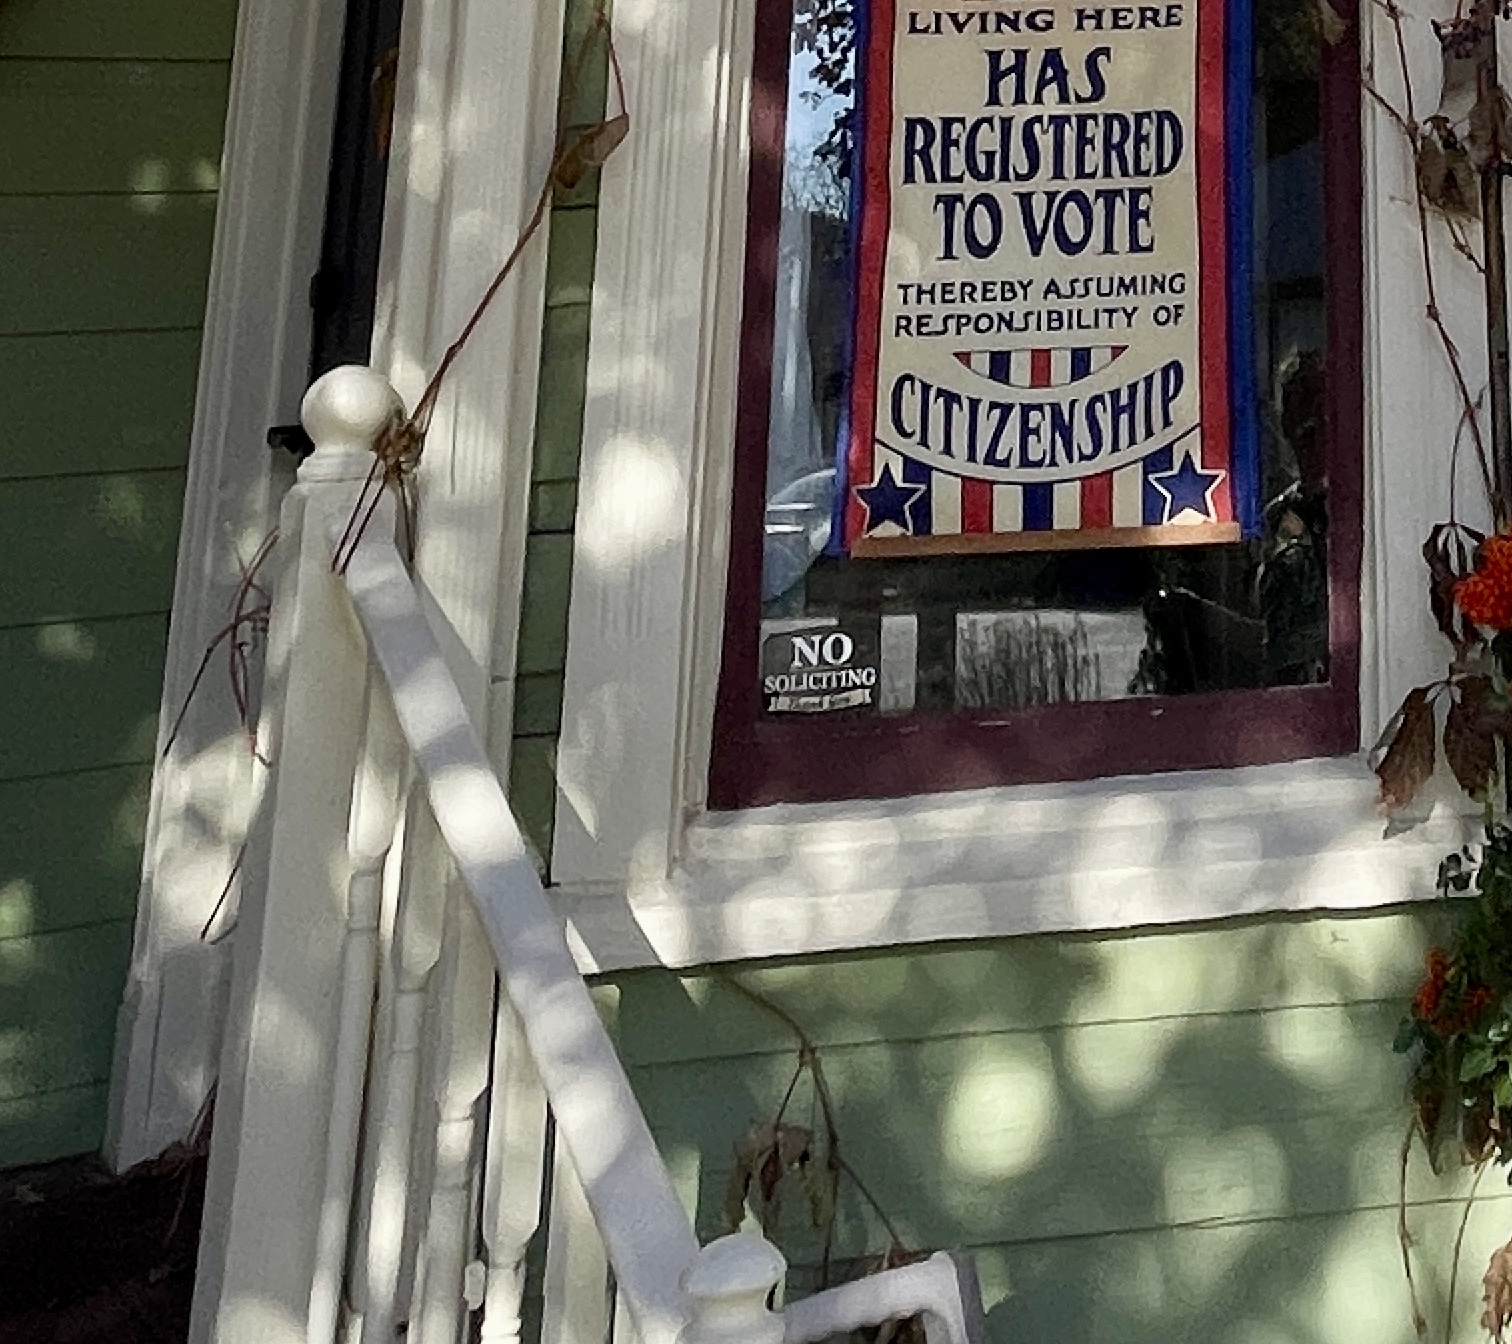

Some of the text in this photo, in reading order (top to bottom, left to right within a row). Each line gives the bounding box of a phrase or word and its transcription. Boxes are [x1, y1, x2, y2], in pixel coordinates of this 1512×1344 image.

[908, 5, 1182, 34] LIVING HERE
[984, 47, 1111, 106] HAS
[903, 111, 1183, 184] REGISTERED
[934, 187, 1154, 260] TO VOTE
[898, 273, 1186, 305] THEREBY ASSUMING
[894, 304, 1185, 337] RESPONSIBILITY OF
[891, 360, 1184, 469] CITIZENSHIP
[791, 633, 853, 667] NO
[764, 667, 876, 693] SOLICITING
